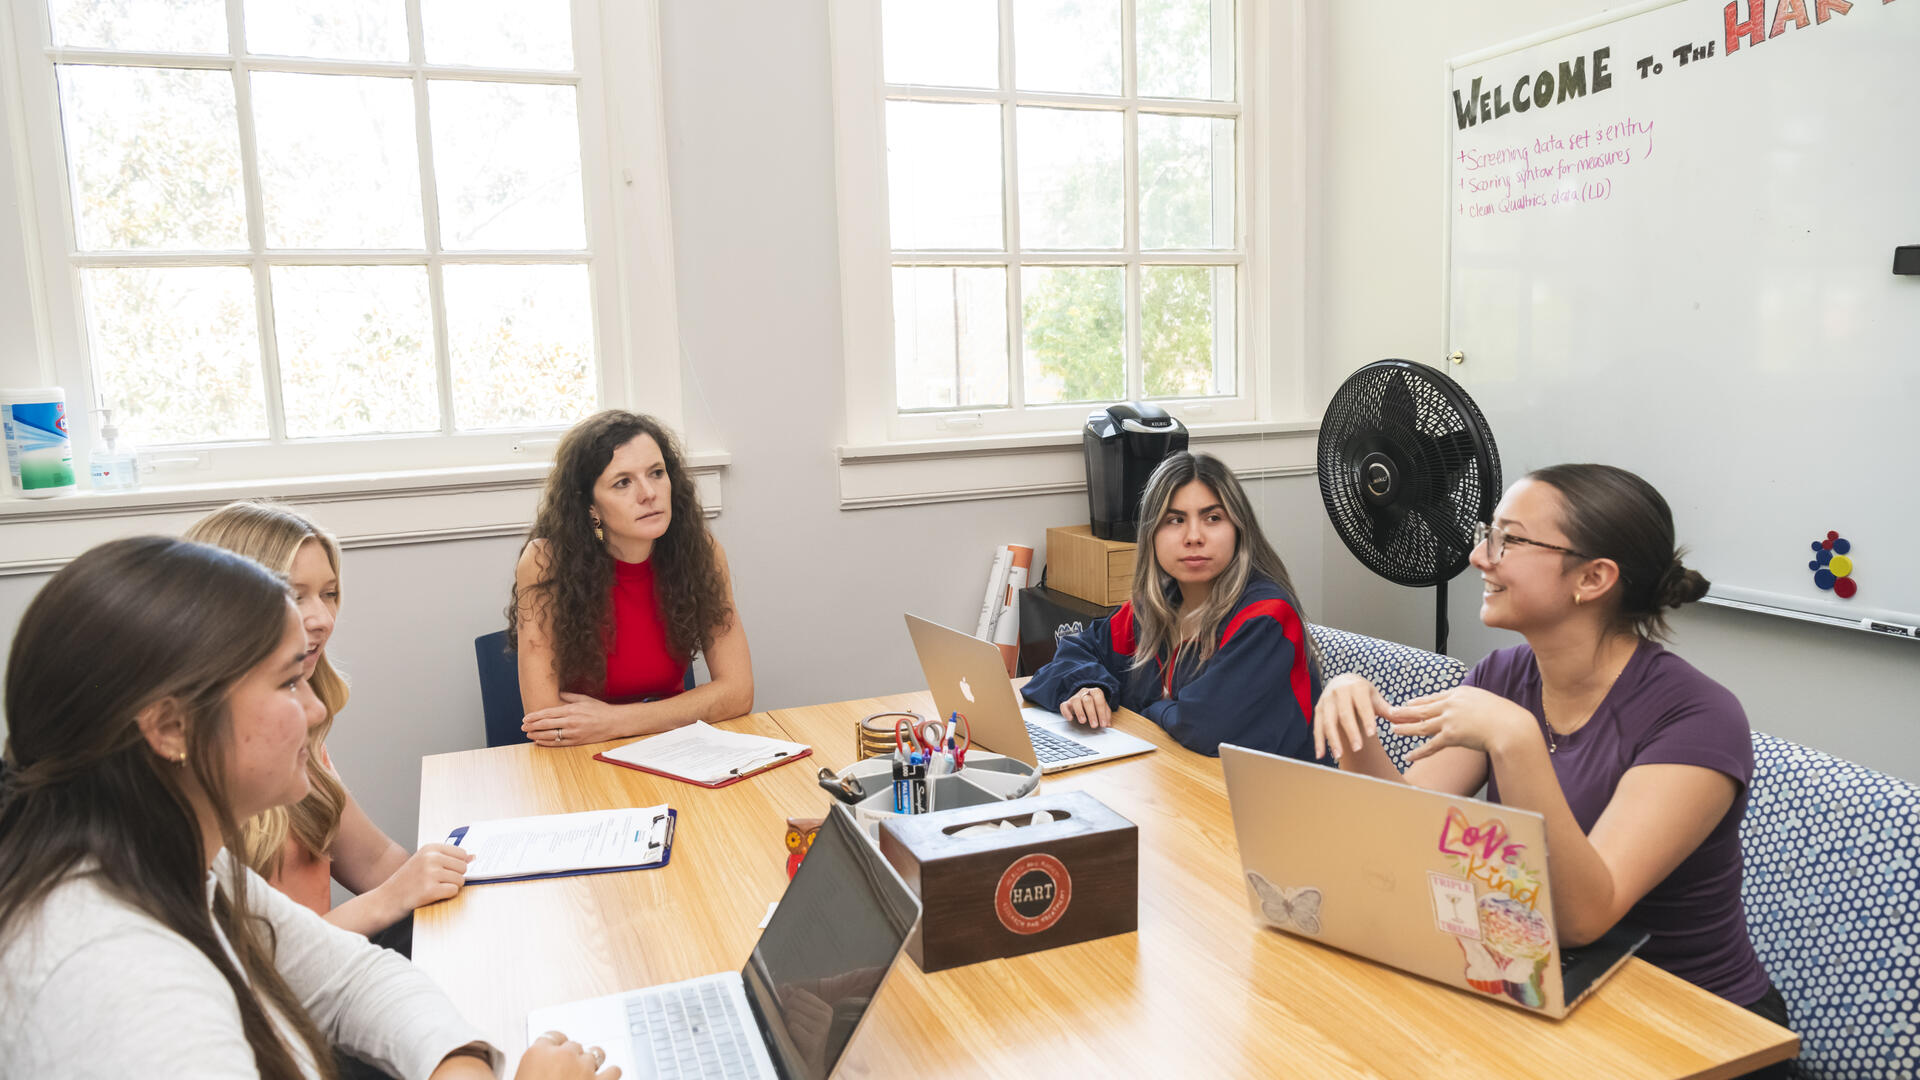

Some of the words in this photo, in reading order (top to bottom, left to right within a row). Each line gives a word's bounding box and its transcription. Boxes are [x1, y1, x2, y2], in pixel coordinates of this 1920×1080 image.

[1453, 46, 1611, 130] WELCOME
[1724, 0, 1896, 56] HA
[1534, 134, 1564, 154] data
[1569, 129, 1590, 150] set
[1606, 117, 1654, 159] entry
[1468, 175, 1510, 198] Scoring
[1516, 165, 1554, 189] syntax
[1557, 158, 1576, 180] for
[1577, 148, 1630, 173] measures
[1552, 188, 1579, 204] data
[1581, 177, 1611, 202] (LD)
[1012, 884, 1053, 903] HART
